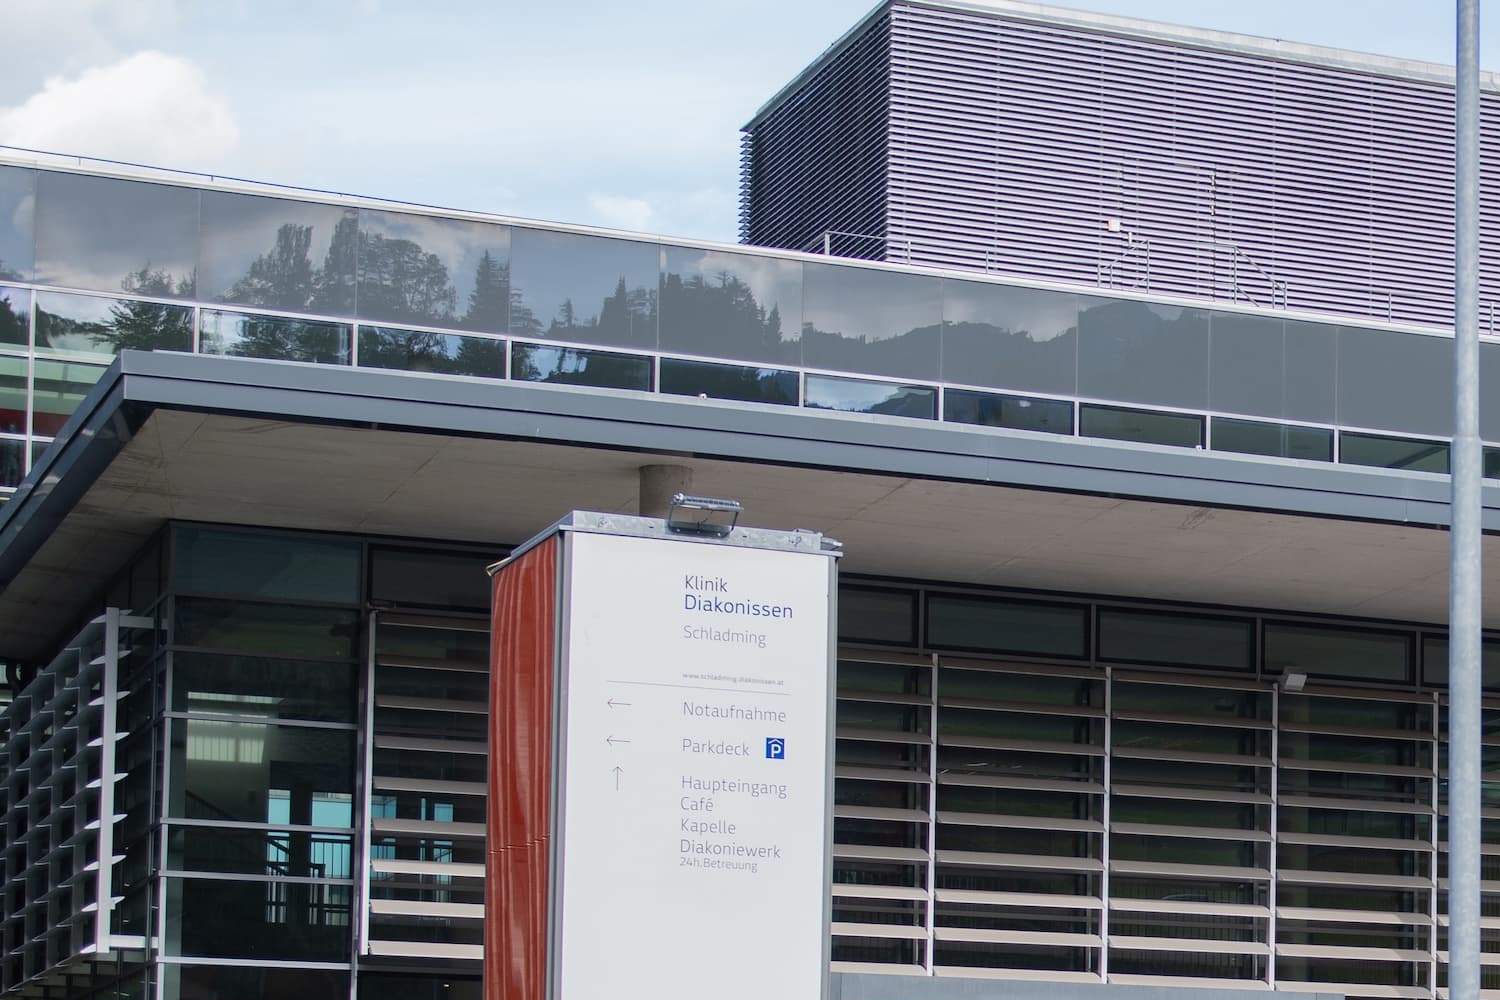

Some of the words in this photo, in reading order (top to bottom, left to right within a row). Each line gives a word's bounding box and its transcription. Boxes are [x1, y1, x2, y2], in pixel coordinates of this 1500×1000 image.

[685, 575, 728, 593] Klinik
[685, 594, 793, 619] Diakonissen
[683, 625, 767, 649] Schladming
[683, 701, 787, 722] Notaufnahme
[682, 738, 750, 756] Parkdeck
[681, 776, 787, 799] Haupteingang
[680, 797, 714, 812] Café
[681, 818, 736, 836] Kapelle
[680, 839, 781, 858] Diakoniewerk
